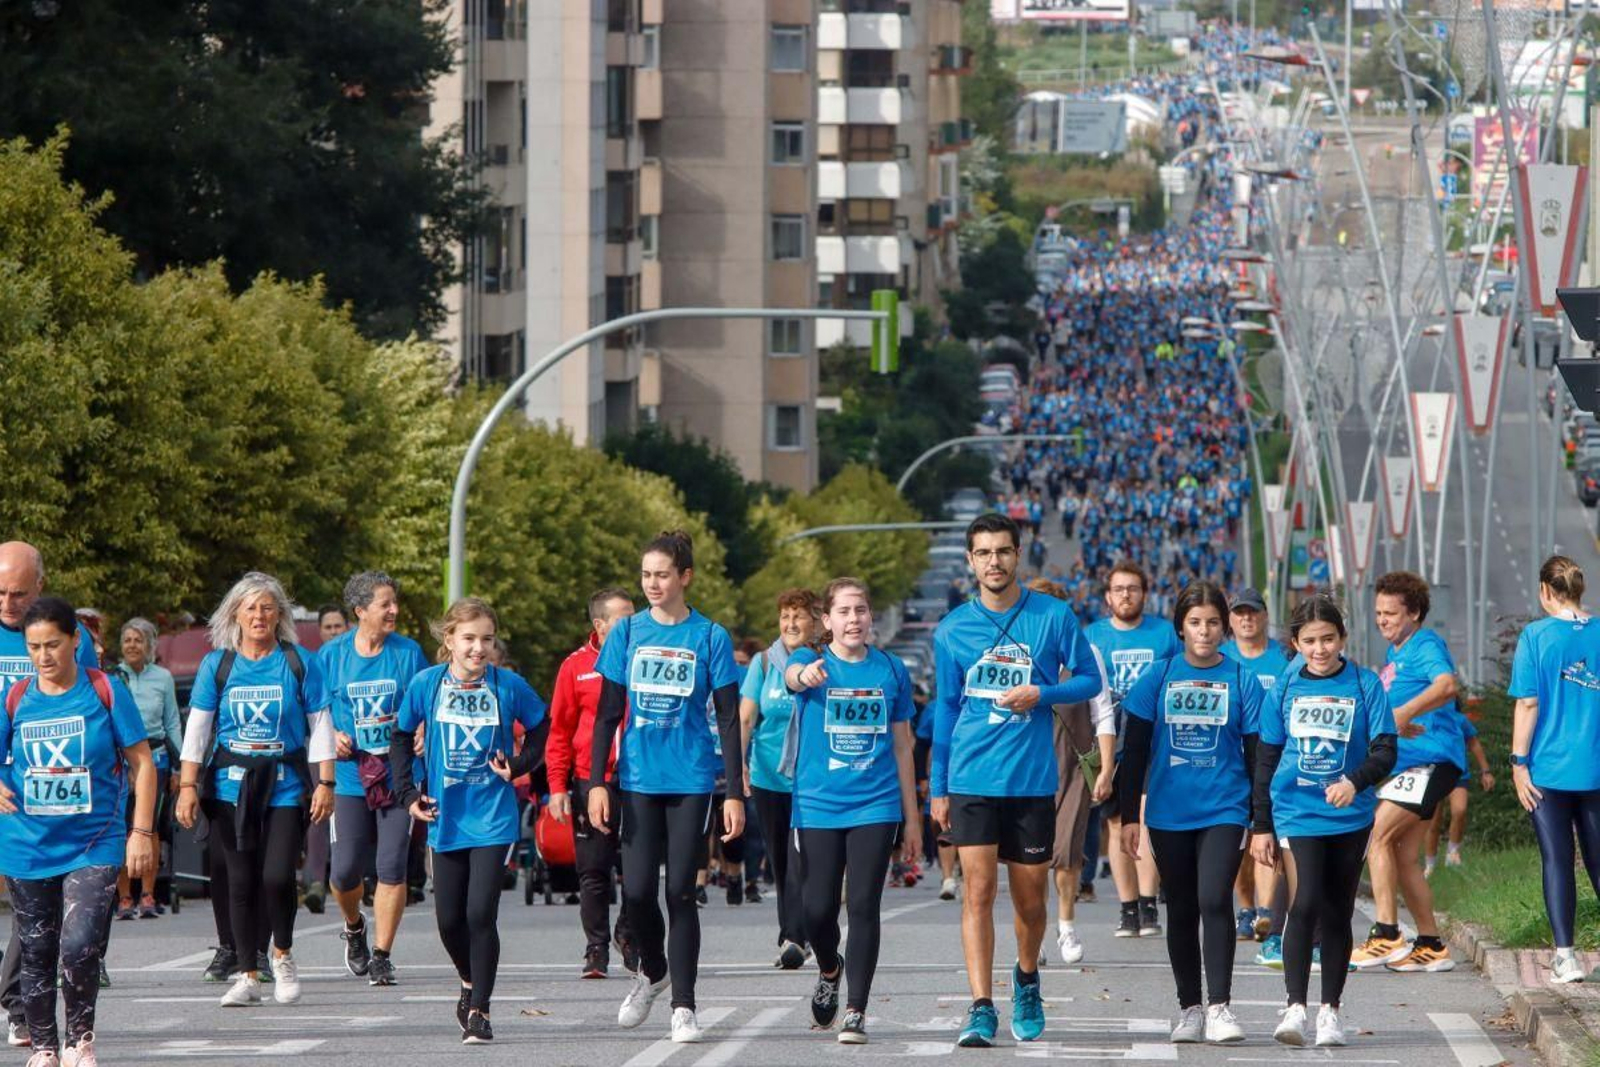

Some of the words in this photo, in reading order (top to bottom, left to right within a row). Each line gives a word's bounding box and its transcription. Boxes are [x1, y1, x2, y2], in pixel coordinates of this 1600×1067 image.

[640, 660, 688, 682] 1768
[976, 665, 1023, 687] 1980
[357, 695, 386, 718] IX
[834, 702, 881, 720] 1629
[1172, 692, 1221, 711] 3627
[237, 702, 270, 724] IX
[1298, 707, 1347, 726] 2902
[449, 723, 482, 751] IX
[32, 738, 73, 767] IX
[32, 779, 83, 801] 1764
[1394, 775, 1416, 791] 33
